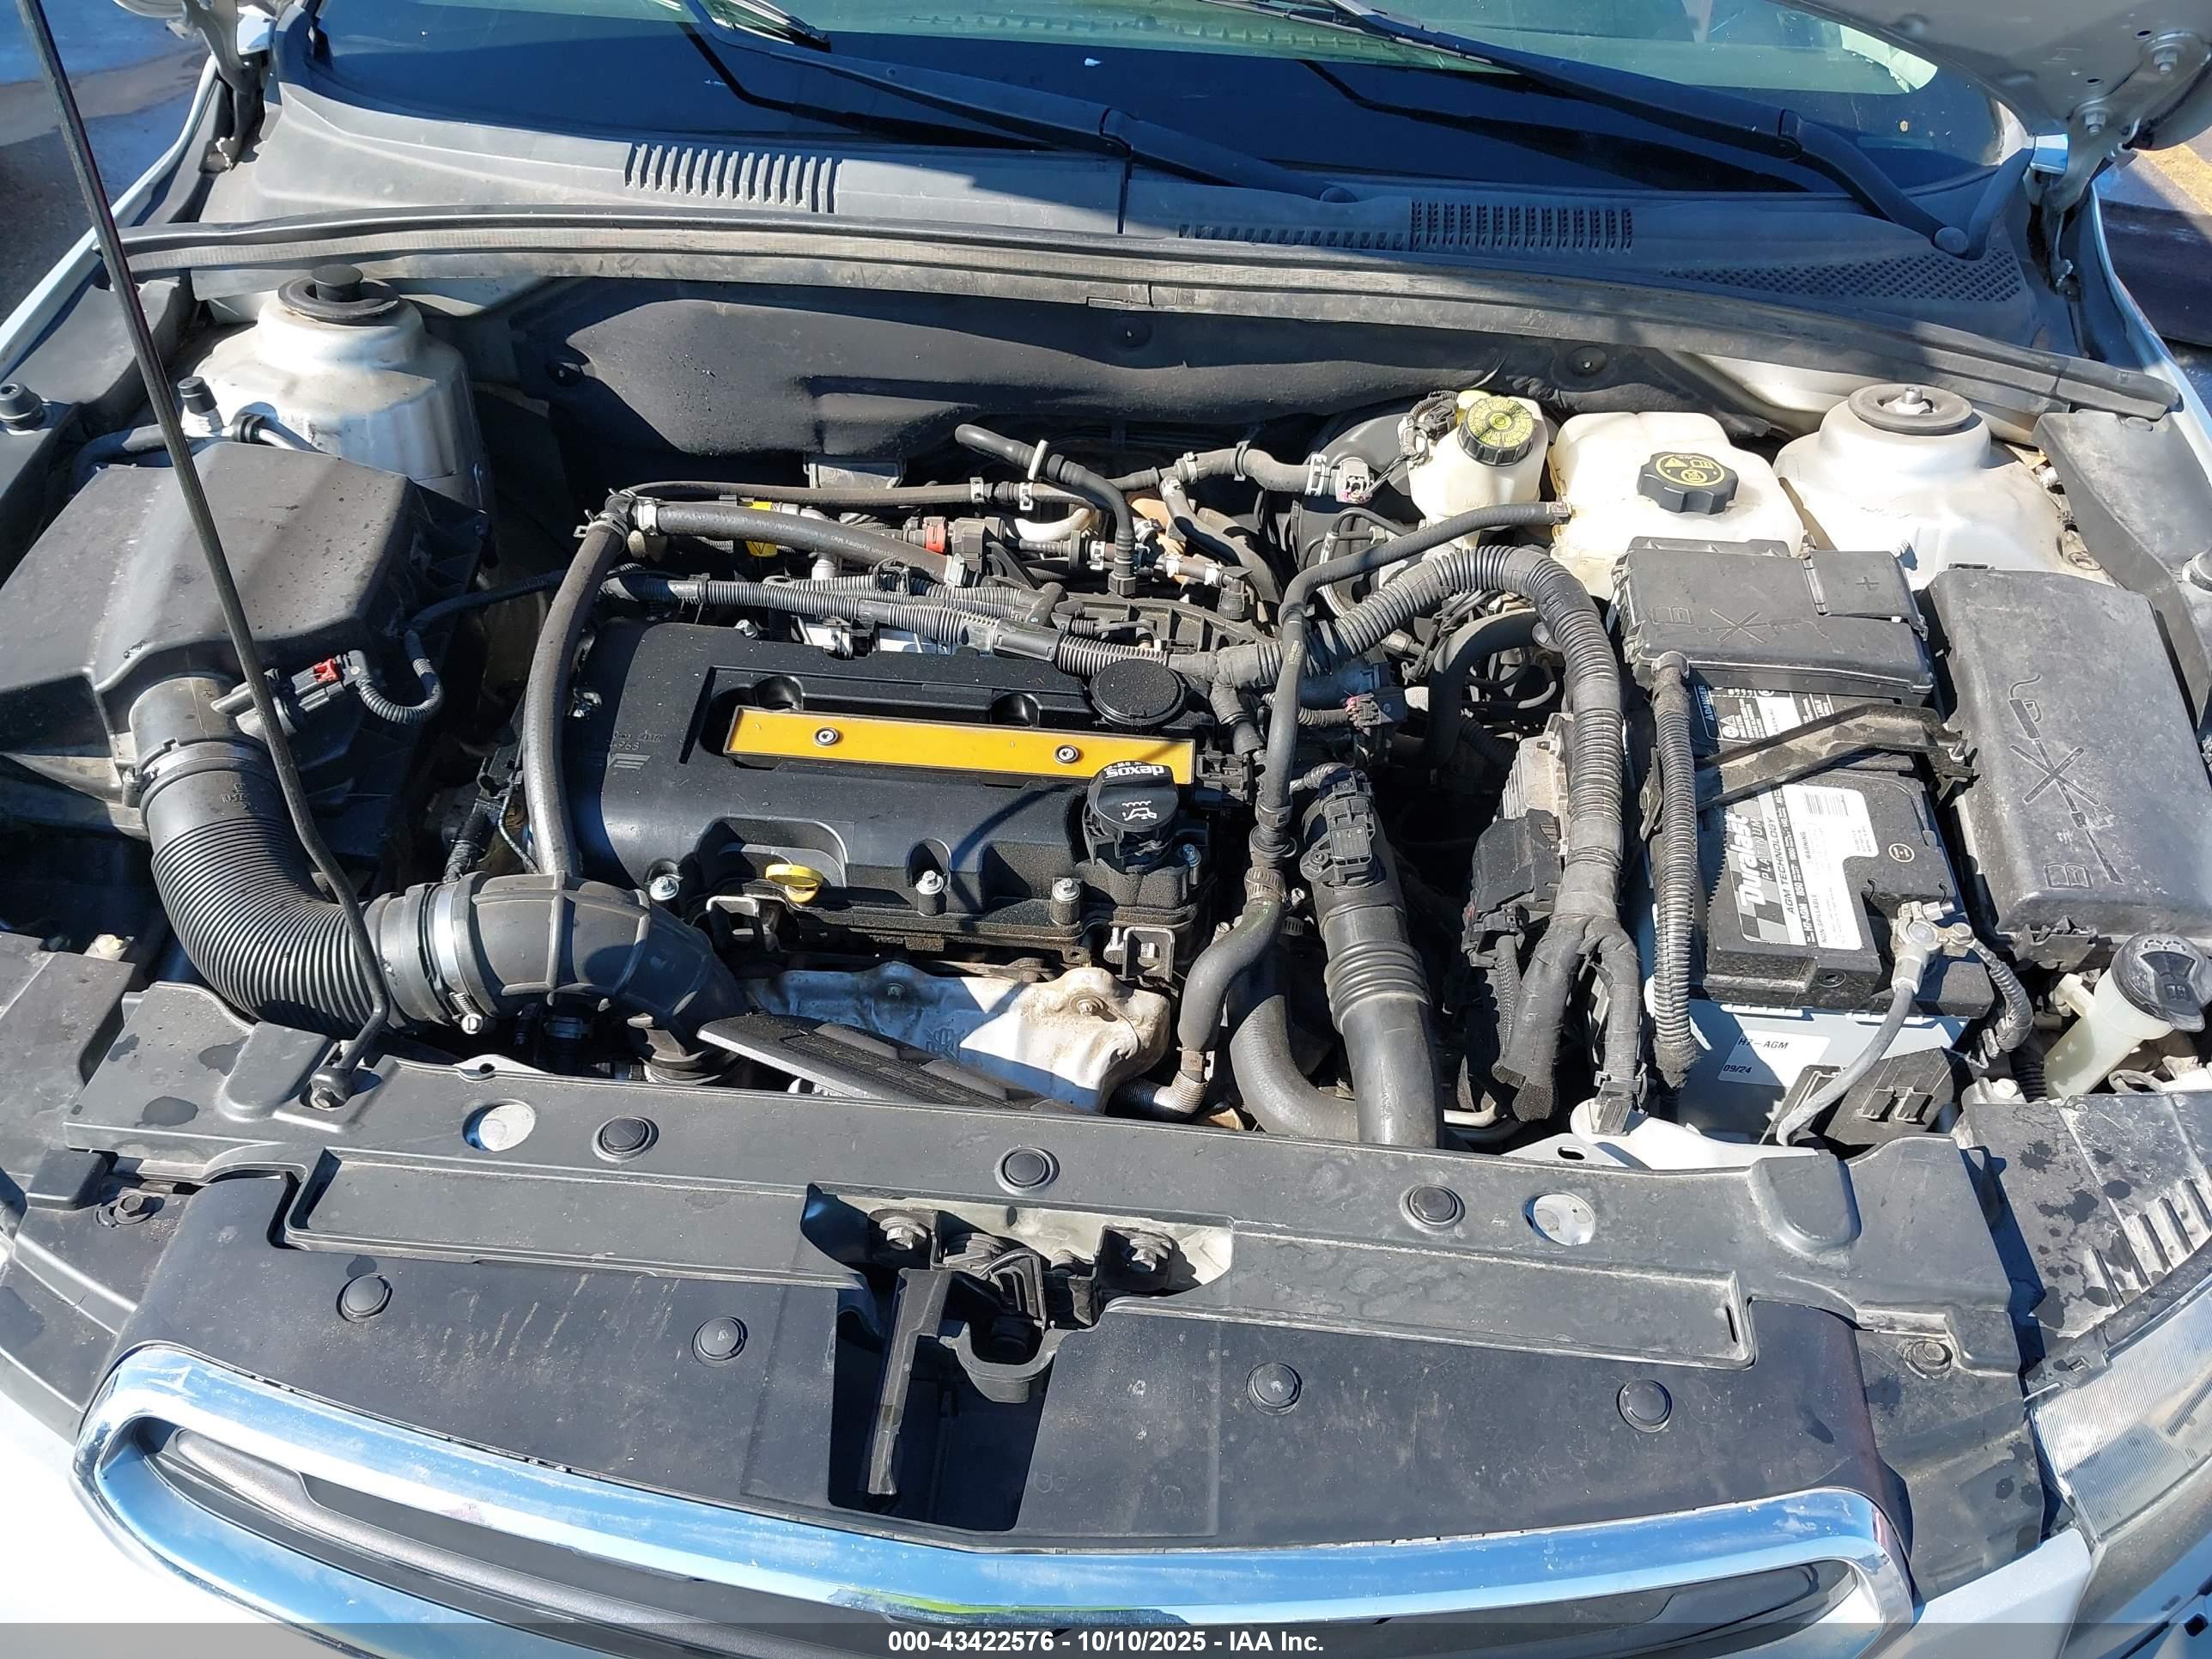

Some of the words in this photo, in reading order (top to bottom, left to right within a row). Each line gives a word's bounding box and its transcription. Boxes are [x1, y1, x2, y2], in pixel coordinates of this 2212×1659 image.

[1698, 685, 1714, 714] DANGER
[1105, 765, 1164, 778] dexos
[1725, 811, 1765, 906] Duralast
[1750, 817, 1773, 881] PLATINUM
[1766, 817, 1789, 887] TECHNOLOGY
[1783, 890, 1796, 915] AGM
[1798, 902, 1814, 932] H7-AGM
[1723, 1064, 1752, 1073] 09/24
